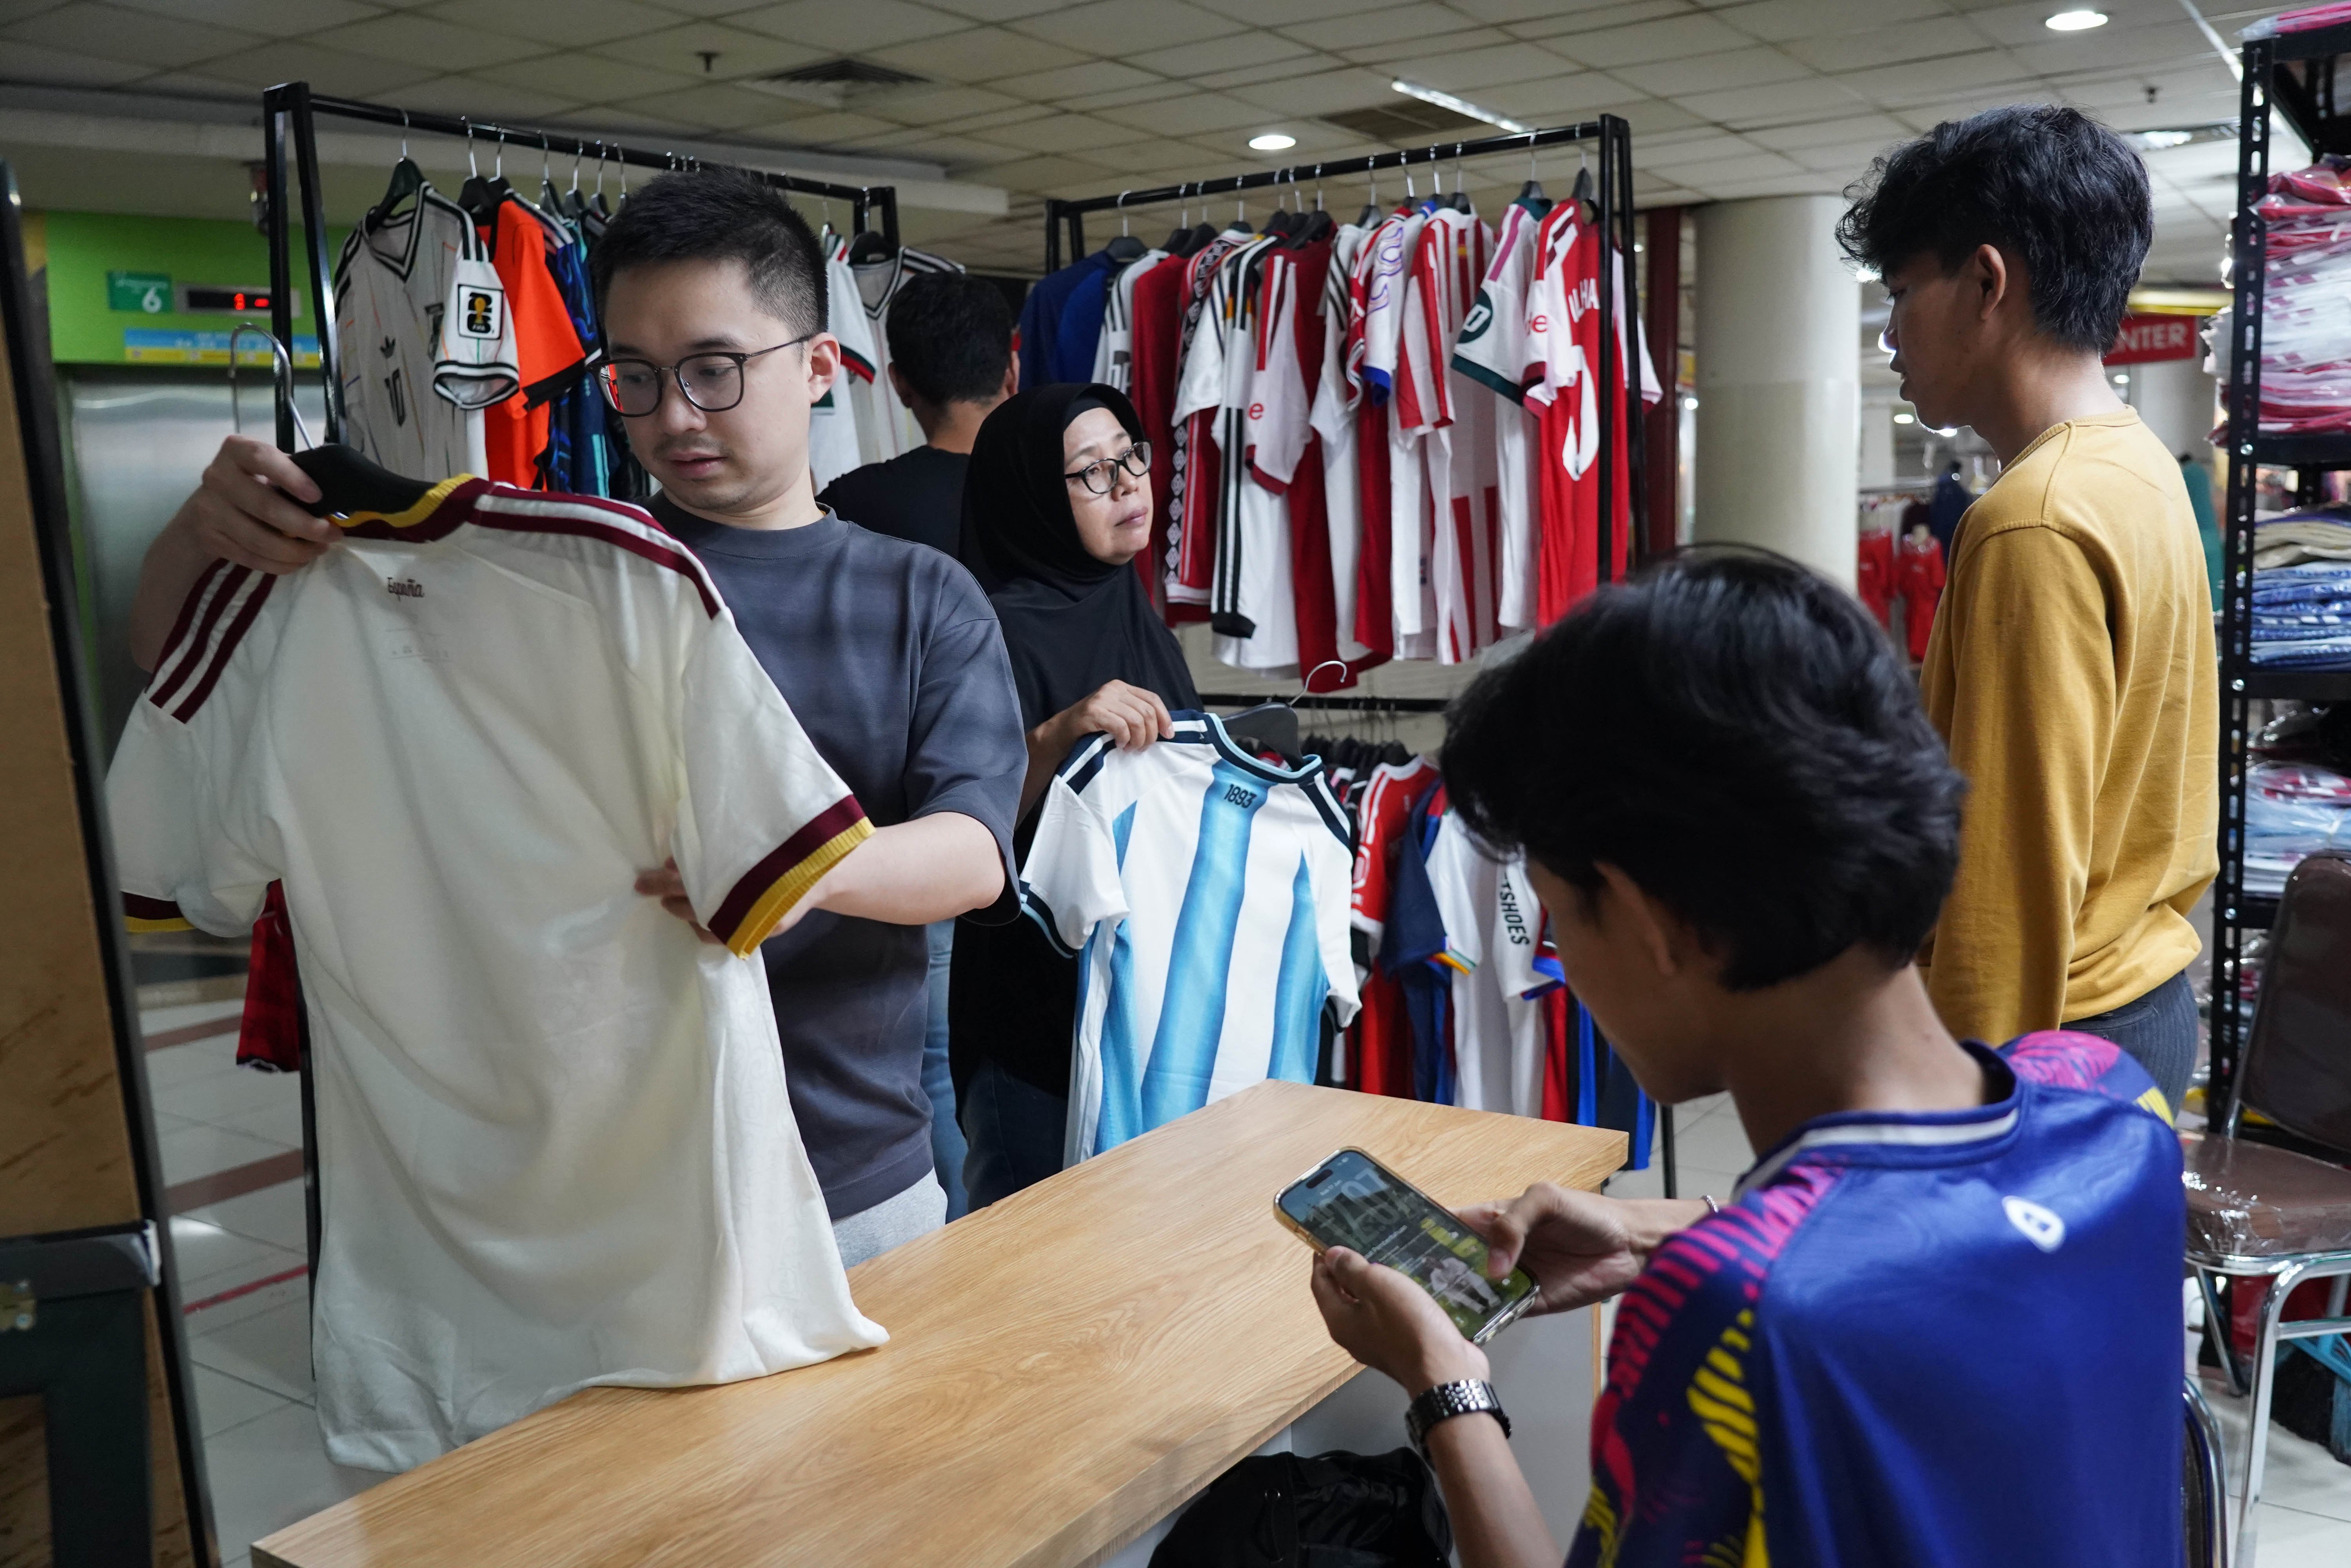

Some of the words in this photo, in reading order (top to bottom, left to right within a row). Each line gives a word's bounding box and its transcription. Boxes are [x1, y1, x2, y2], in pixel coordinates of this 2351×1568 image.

[142, 286, 162, 313] 6
[2113, 322, 2186, 353] NTER
[1224, 783, 1258, 808] 1893
[1500, 872, 1530, 946] TSHOES
